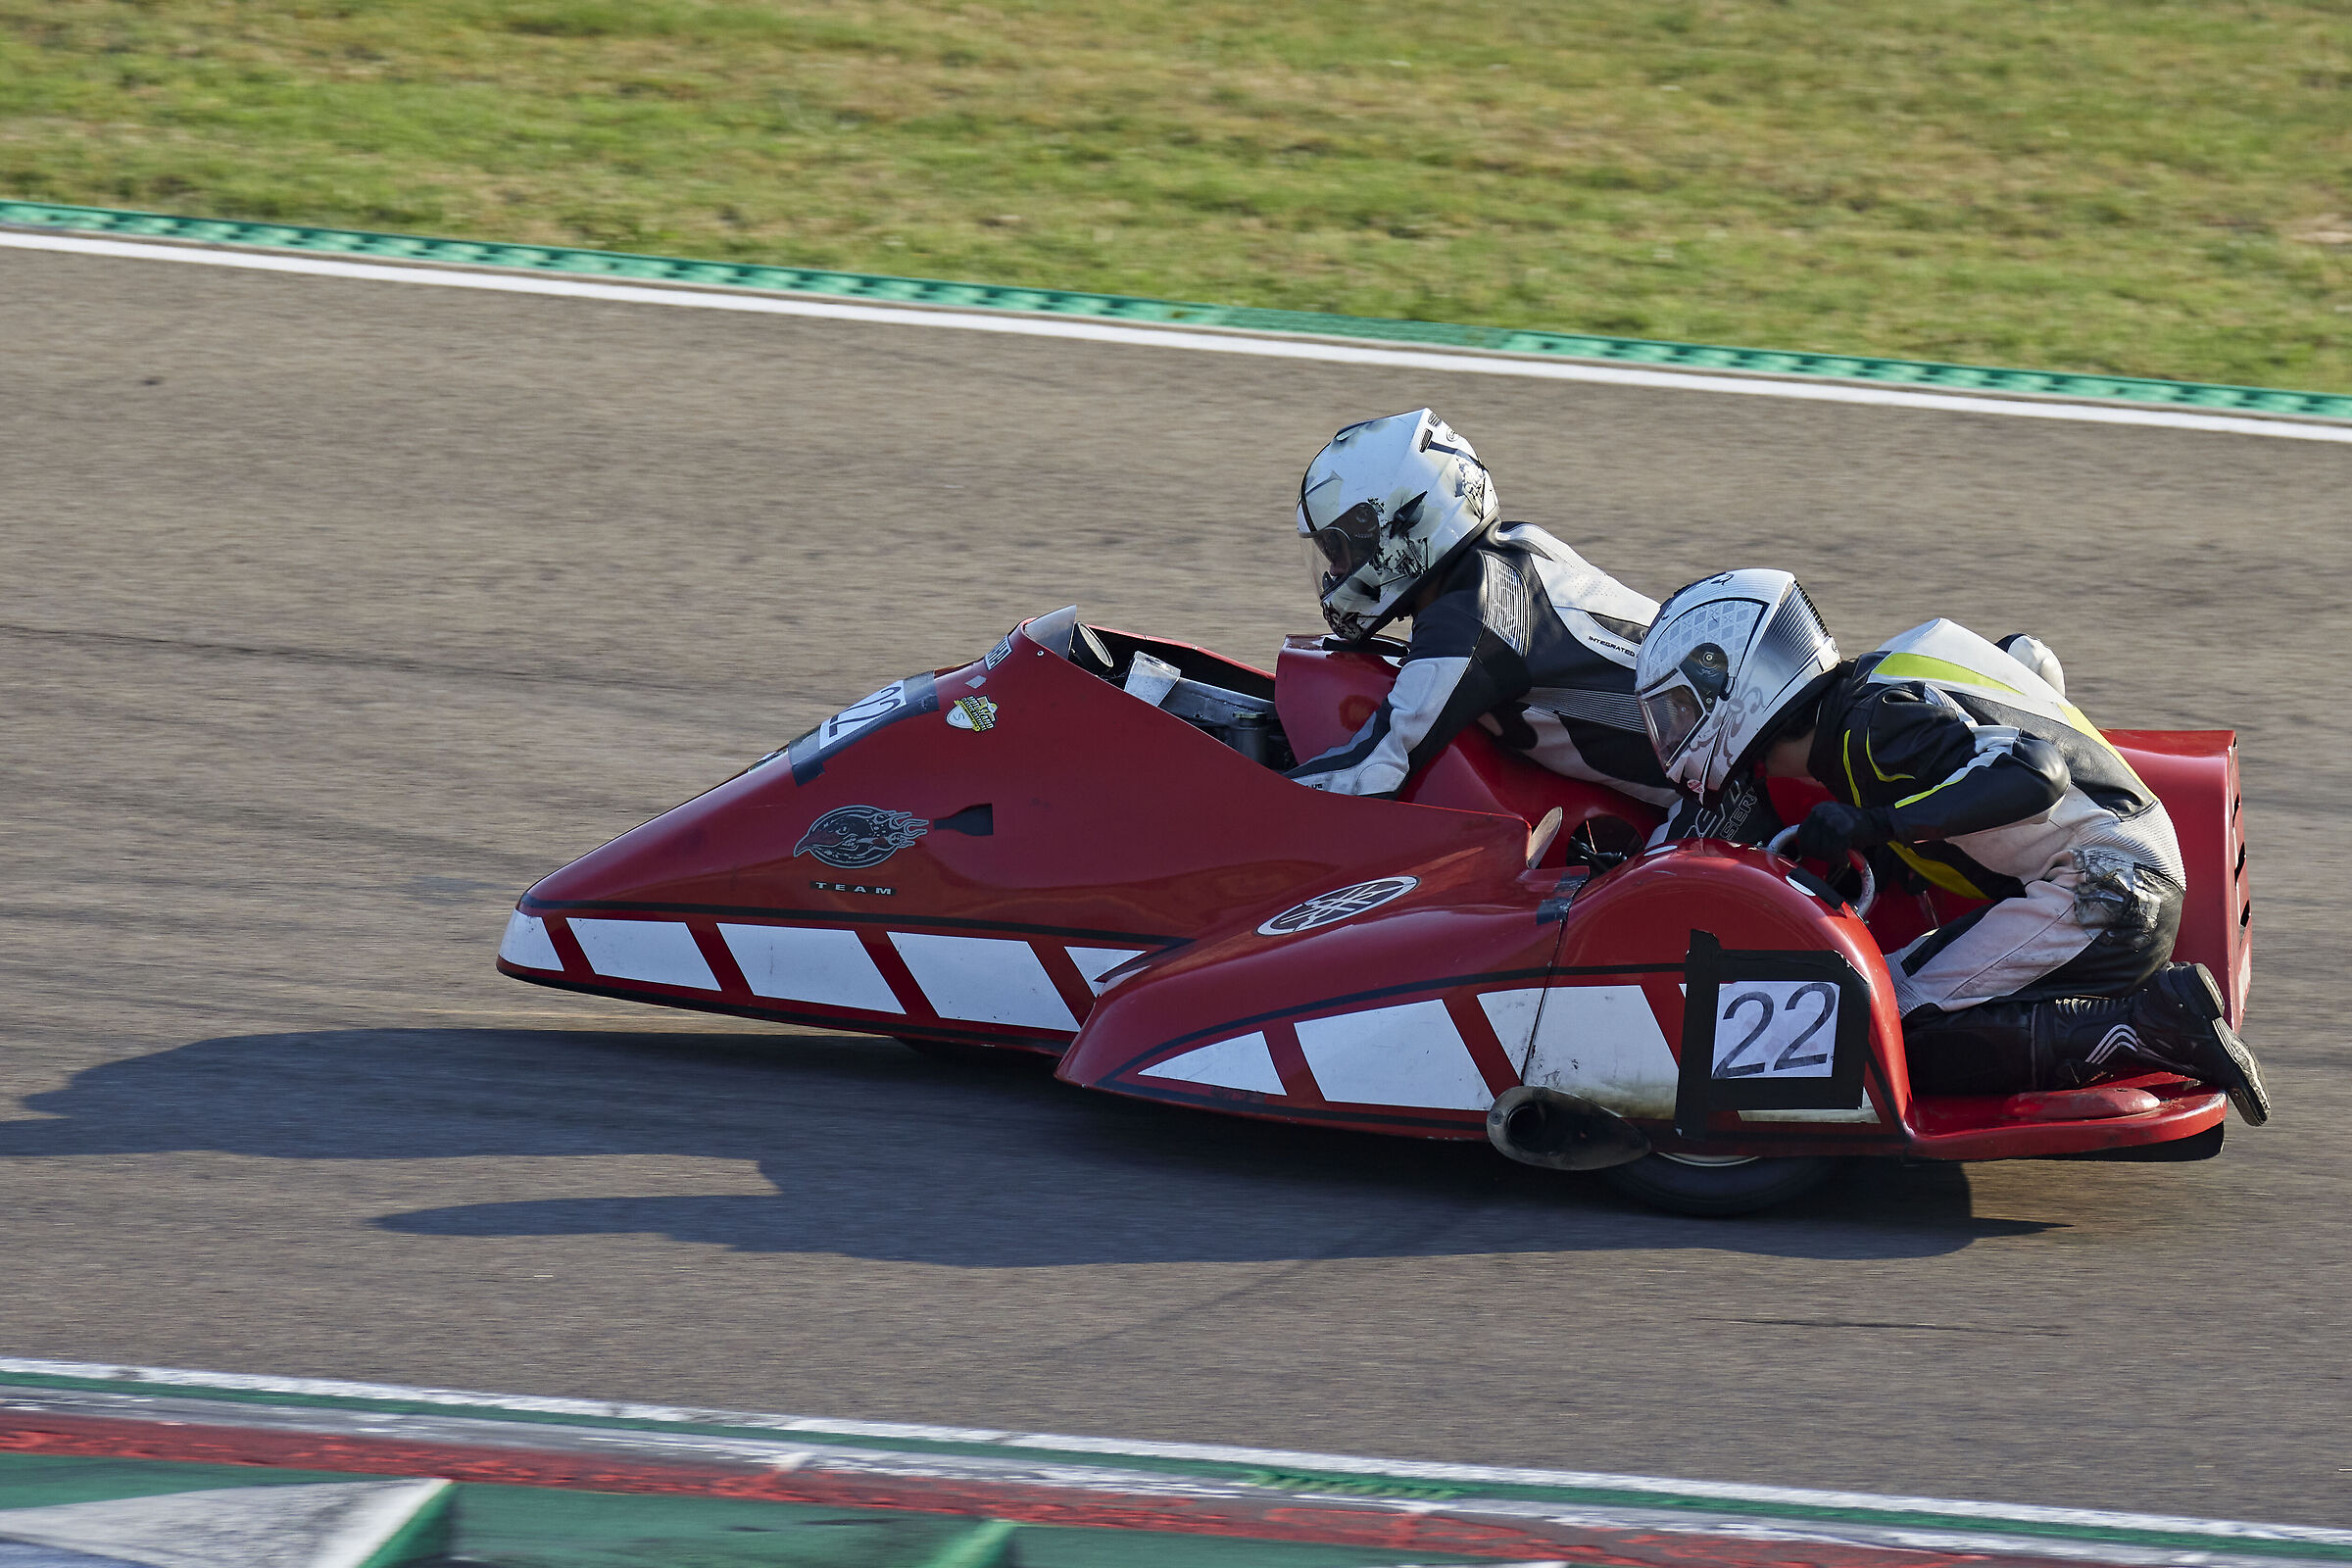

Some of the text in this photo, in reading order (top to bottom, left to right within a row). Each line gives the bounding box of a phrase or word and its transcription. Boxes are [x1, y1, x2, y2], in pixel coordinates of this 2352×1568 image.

[1588, 635, 1636, 658] INTEGRATED
[828, 686, 901, 739] 22
[815, 881, 892, 895] TEAM
[1711, 982, 1837, 1079] 22
